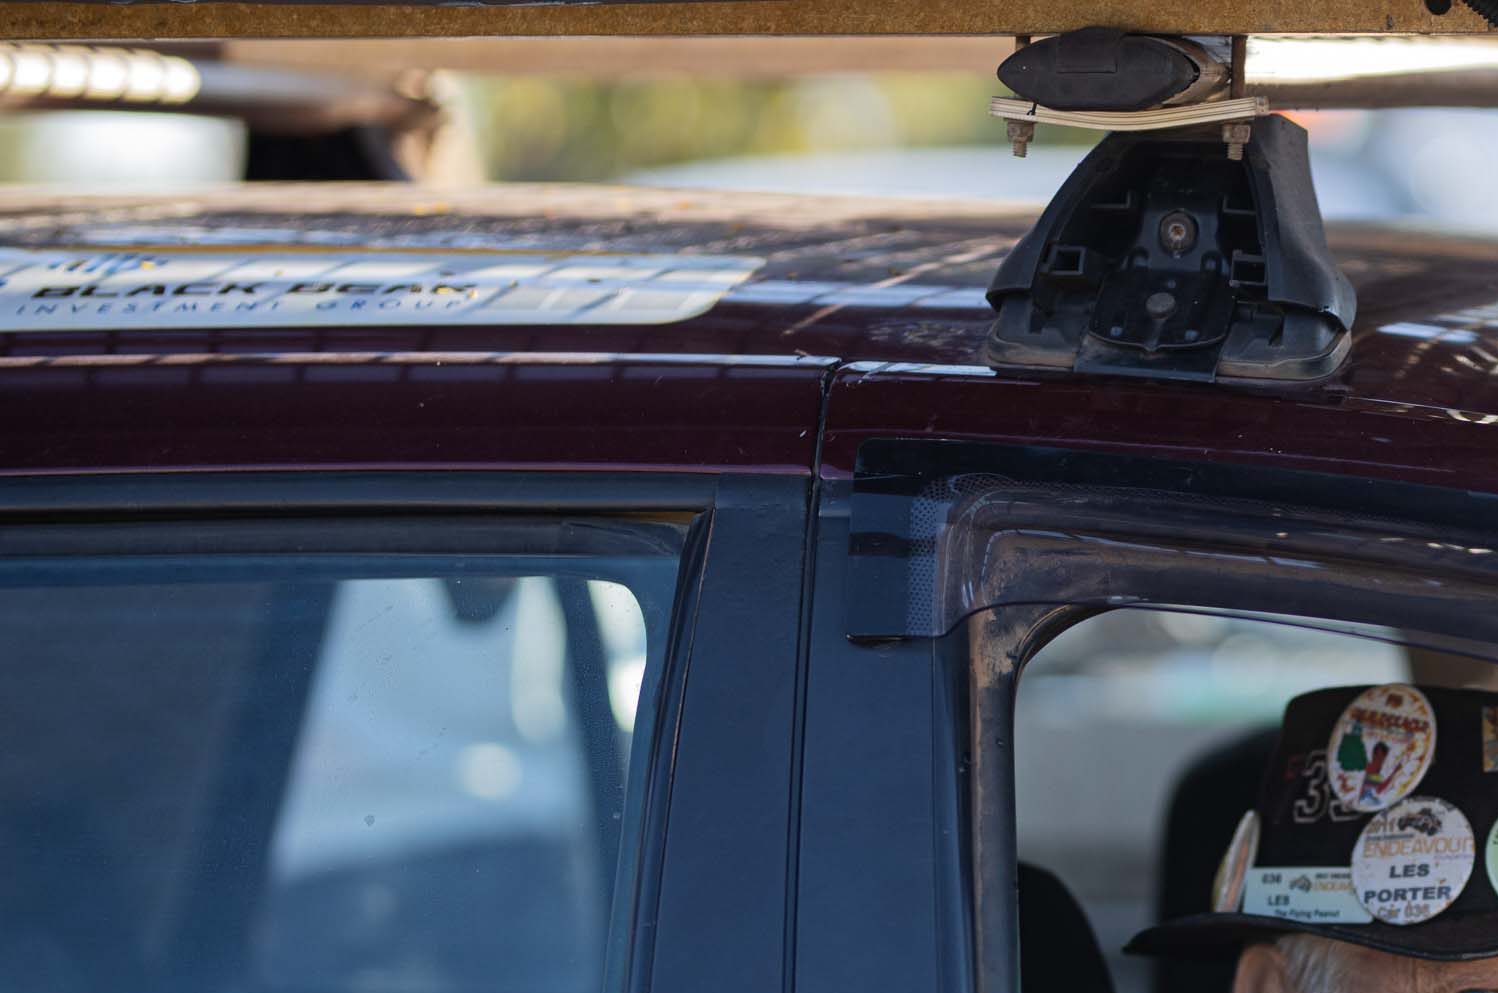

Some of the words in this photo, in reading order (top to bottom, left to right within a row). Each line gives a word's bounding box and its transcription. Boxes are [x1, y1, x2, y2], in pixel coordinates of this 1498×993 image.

[30, 280, 260, 299] BLACK
[16, 299, 283, 316] INVESTMENT
[315, 297, 464, 311] GROUP
[1388, 862, 1431, 880] LES
[1267, 894, 1290, 907] LES
[1363, 885, 1453, 905] PORTER
